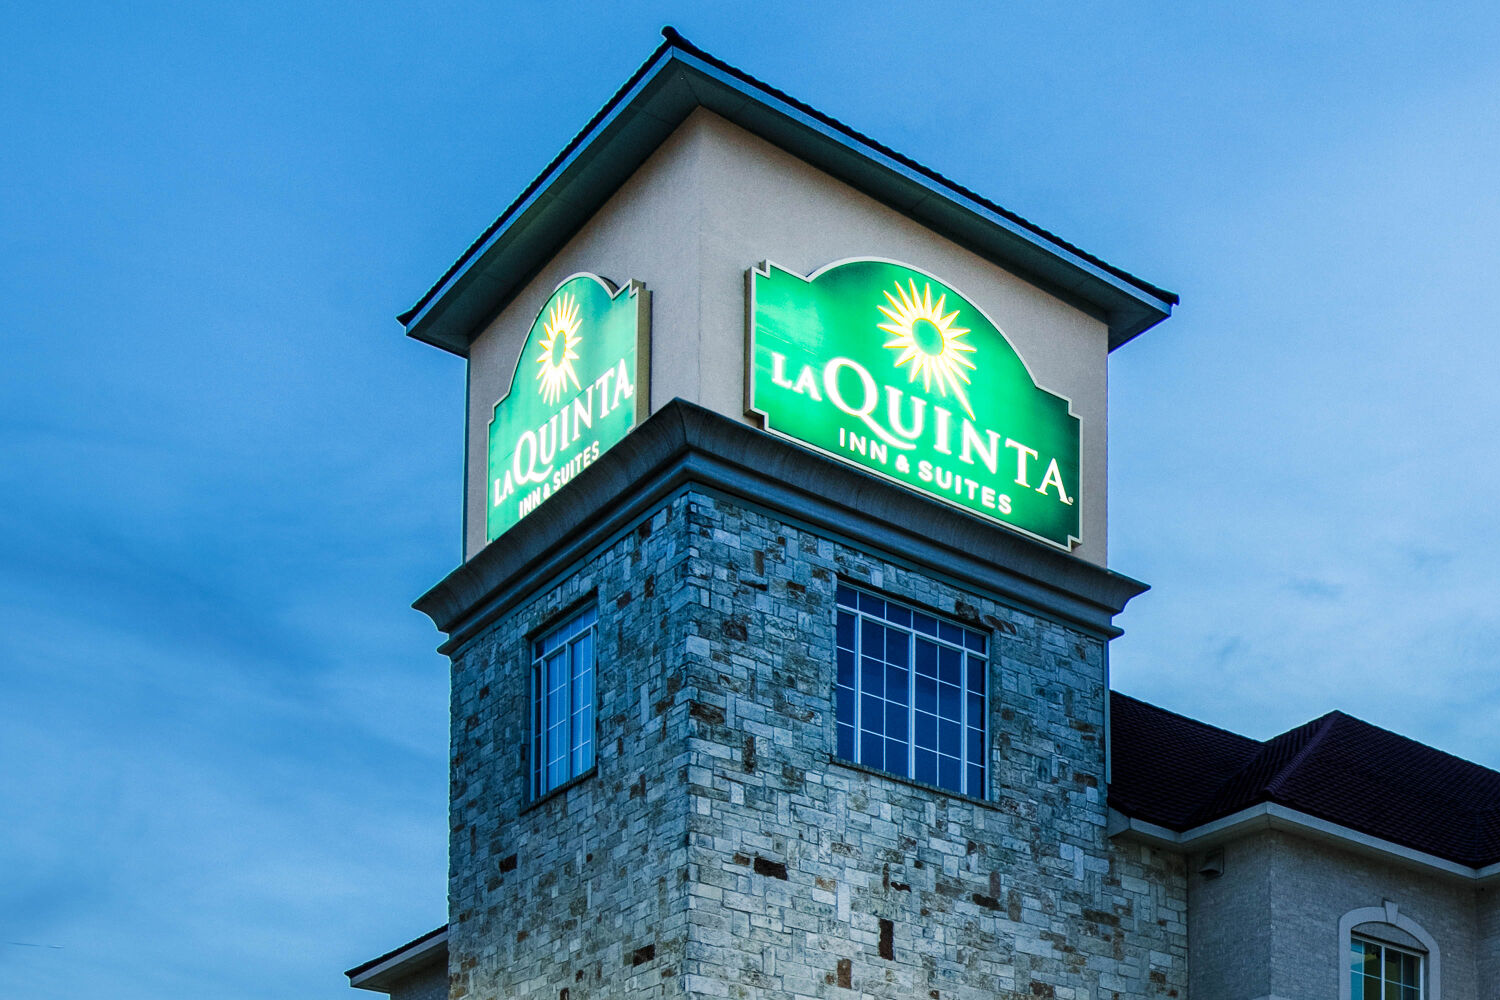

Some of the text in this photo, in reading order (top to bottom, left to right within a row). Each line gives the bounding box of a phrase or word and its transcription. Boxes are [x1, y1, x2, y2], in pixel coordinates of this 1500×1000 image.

[493, 358, 632, 508] LA QUINTA
[519, 440, 600, 520] INN & SUITES
[771, 353, 1073, 506] LA QUINTA
[838, 427, 1012, 515] INN & SUITES
